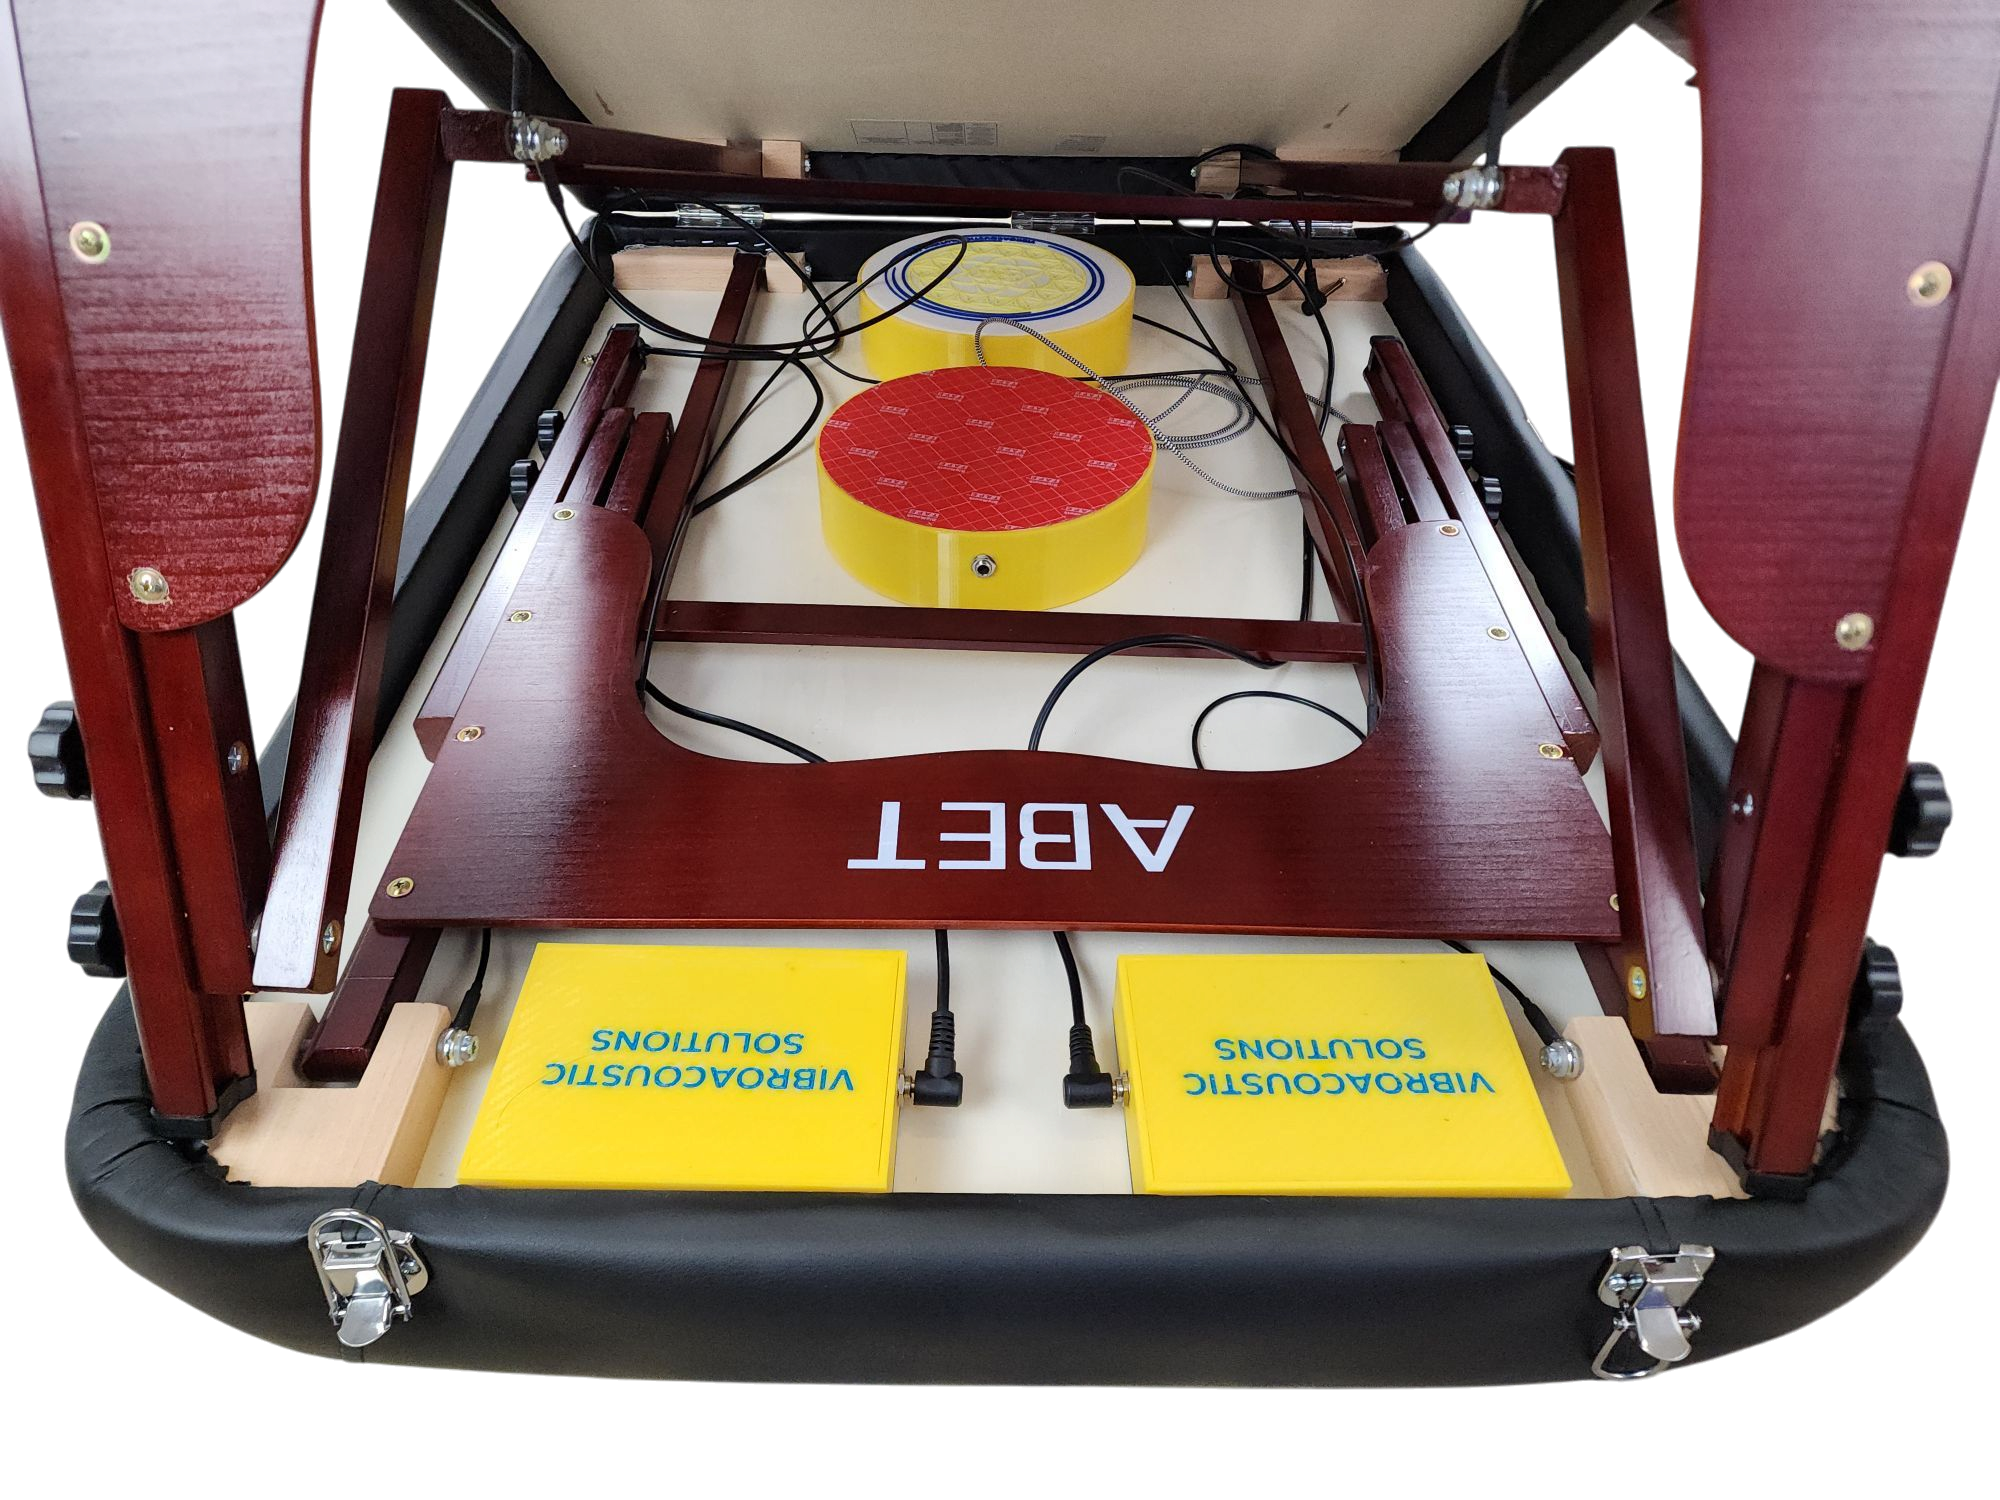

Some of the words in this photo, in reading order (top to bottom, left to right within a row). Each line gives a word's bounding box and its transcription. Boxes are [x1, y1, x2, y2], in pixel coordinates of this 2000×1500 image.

[847, 801, 1195, 873] ABET
[591, 1029, 805, 1054] SOLUTIONS
[1214, 1037, 1425, 1060] SOLUTIONS
[543, 1063, 853, 1090] VIBROACOUSTIC
[1186, 1072, 1493, 1095] VIBROACOUSTIC
